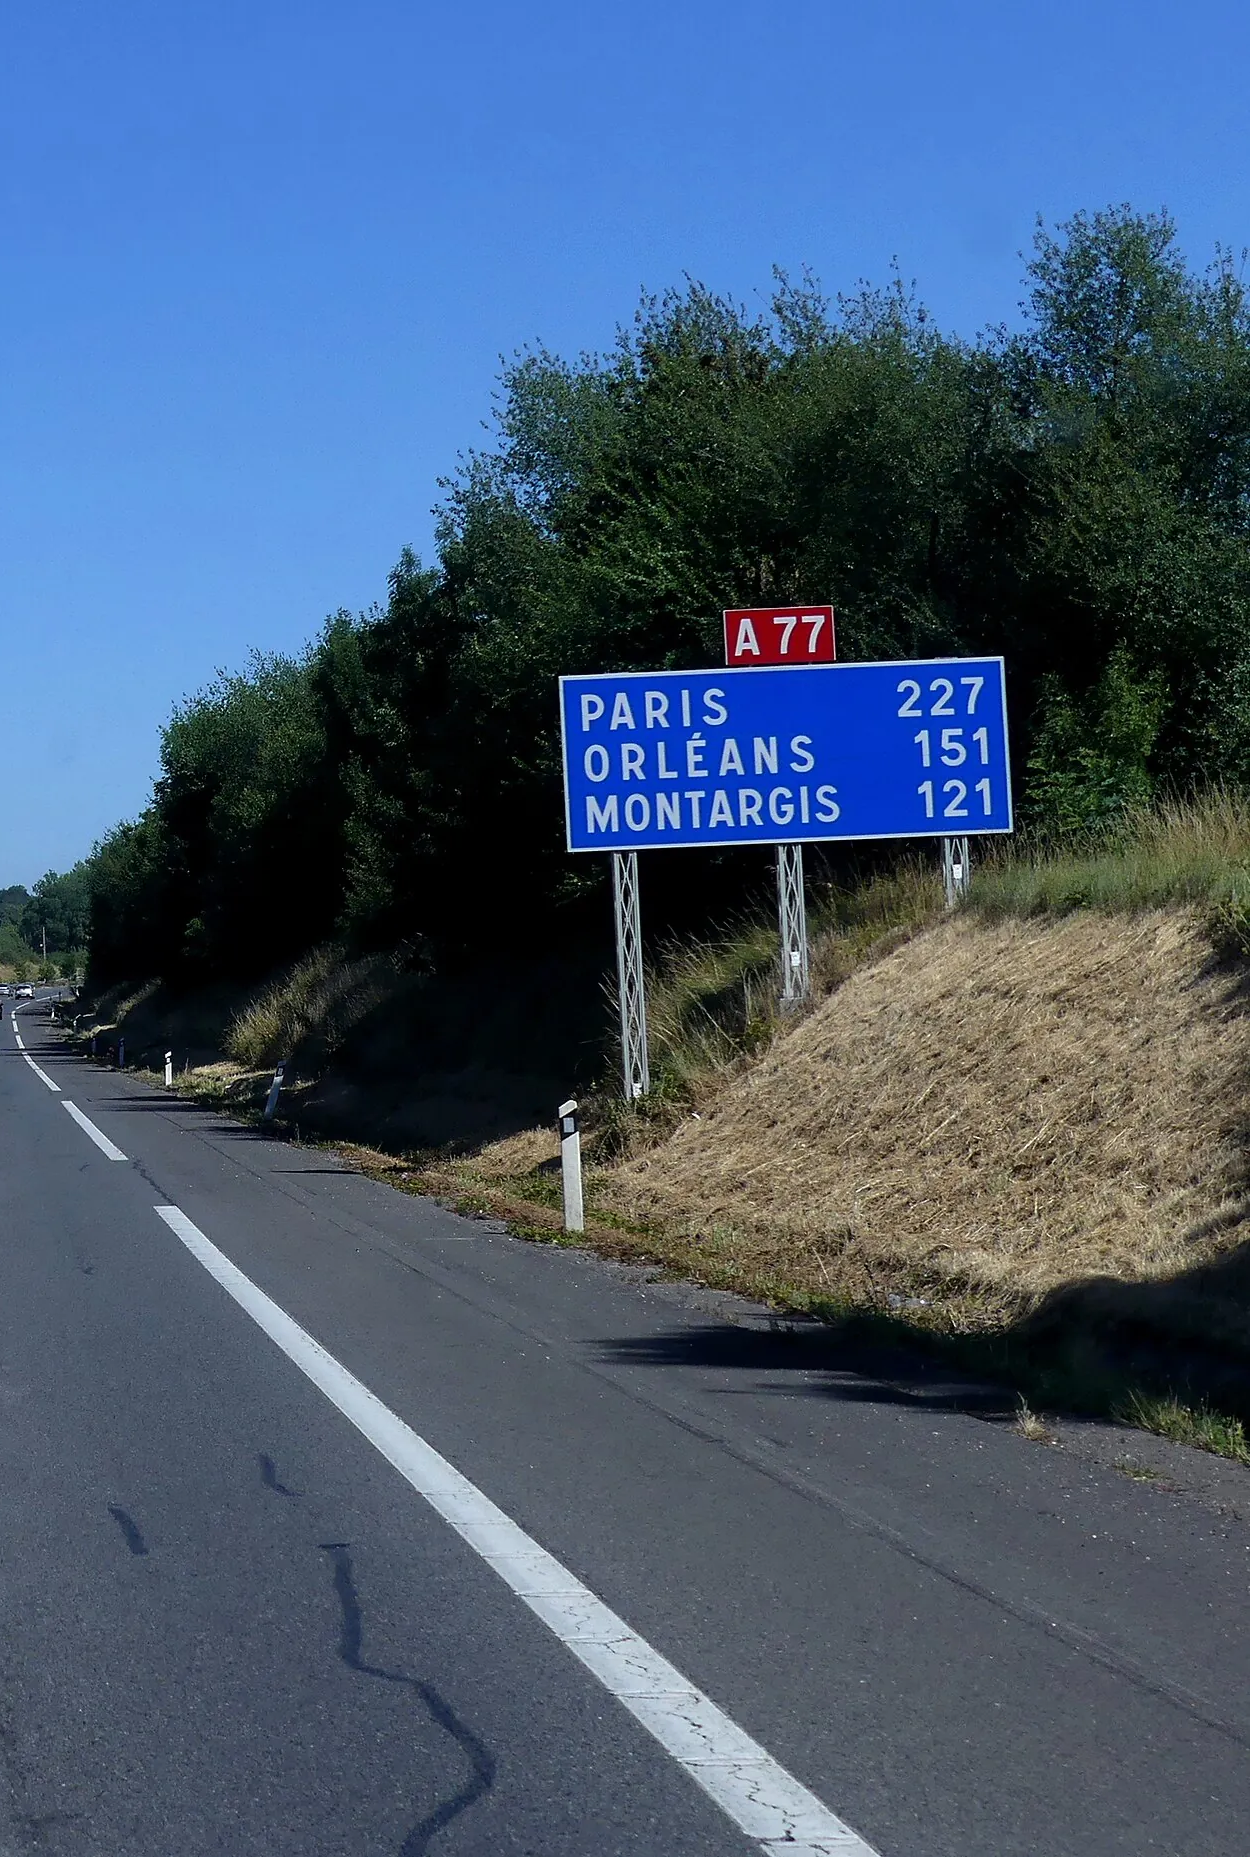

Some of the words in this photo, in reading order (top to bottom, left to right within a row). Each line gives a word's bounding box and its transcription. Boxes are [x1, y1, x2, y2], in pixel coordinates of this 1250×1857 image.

[734, 618, 761, 657] A
[773, 614, 825, 654] 77
[580, 688, 728, 732] PARIS
[896, 676, 984, 717] 227
[583, 732, 815, 782] ORLÉANS
[914, 727, 989, 767] 151
[585, 784, 840, 833] MONTARGIS
[917, 778, 992, 818] 121
